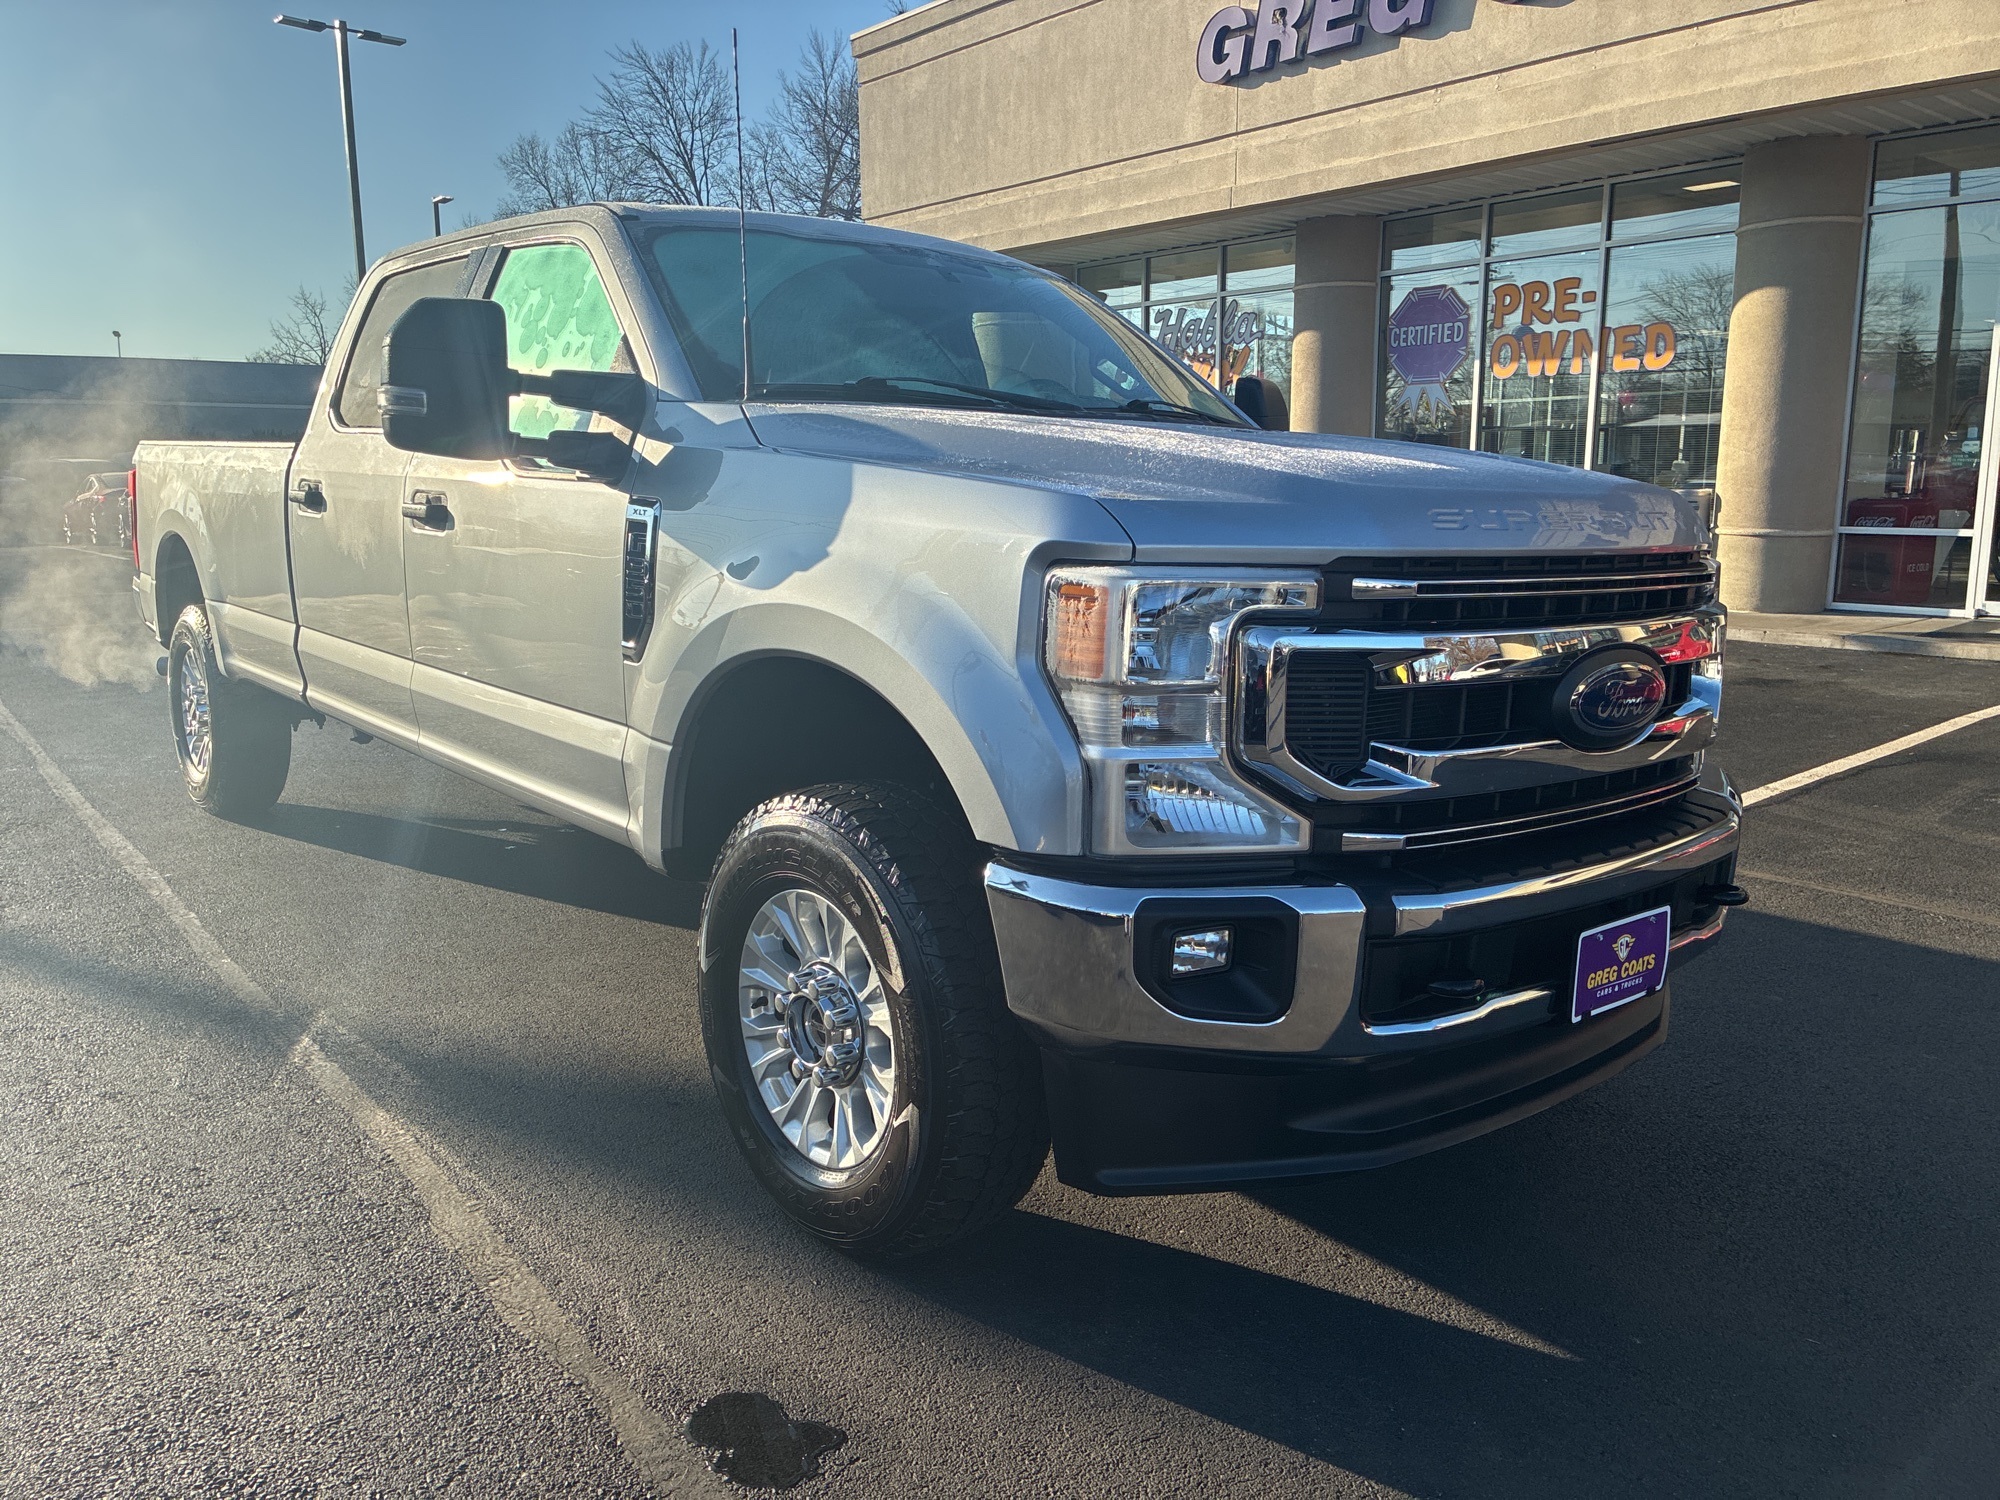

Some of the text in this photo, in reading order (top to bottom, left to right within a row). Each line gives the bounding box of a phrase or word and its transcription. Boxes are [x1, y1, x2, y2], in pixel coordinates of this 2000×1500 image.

[1492, 277, 1597, 330] PRE-
[1154, 299, 1265, 351] Habla
[1390, 322, 1464, 347] CERTIFIED
[1491, 321, 1676, 379] OWNED
[632, 508, 648, 516] XLT
[1598, 679, 1648, 719] Ford
[1587, 953, 1656, 989] GREG COATS
[1596, 987, 1612, 998] CARS
[1621, 976, 1643, 989] TRUCKS
